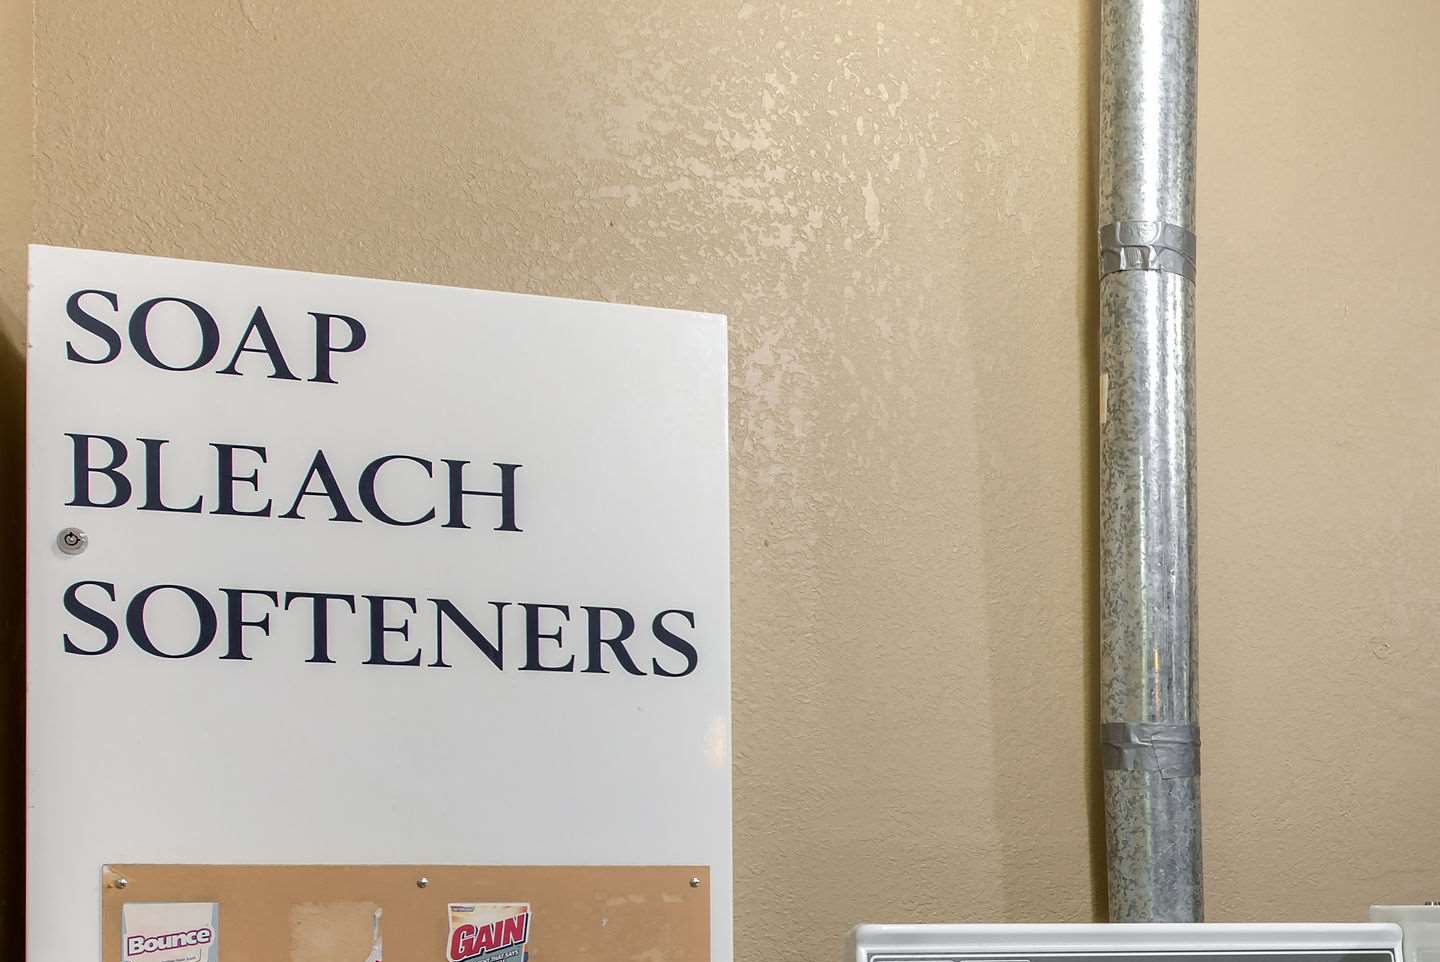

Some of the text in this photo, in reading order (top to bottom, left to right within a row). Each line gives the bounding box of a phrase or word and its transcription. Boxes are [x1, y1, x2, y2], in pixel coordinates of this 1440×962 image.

[65, 289, 367, 385] SOAP
[64, 433, 524, 532] BLEACH
[62, 580, 699, 678] SOFTENERS
[128, 928, 211, 956] Bounce
[450, 912, 528, 962] GAIN
